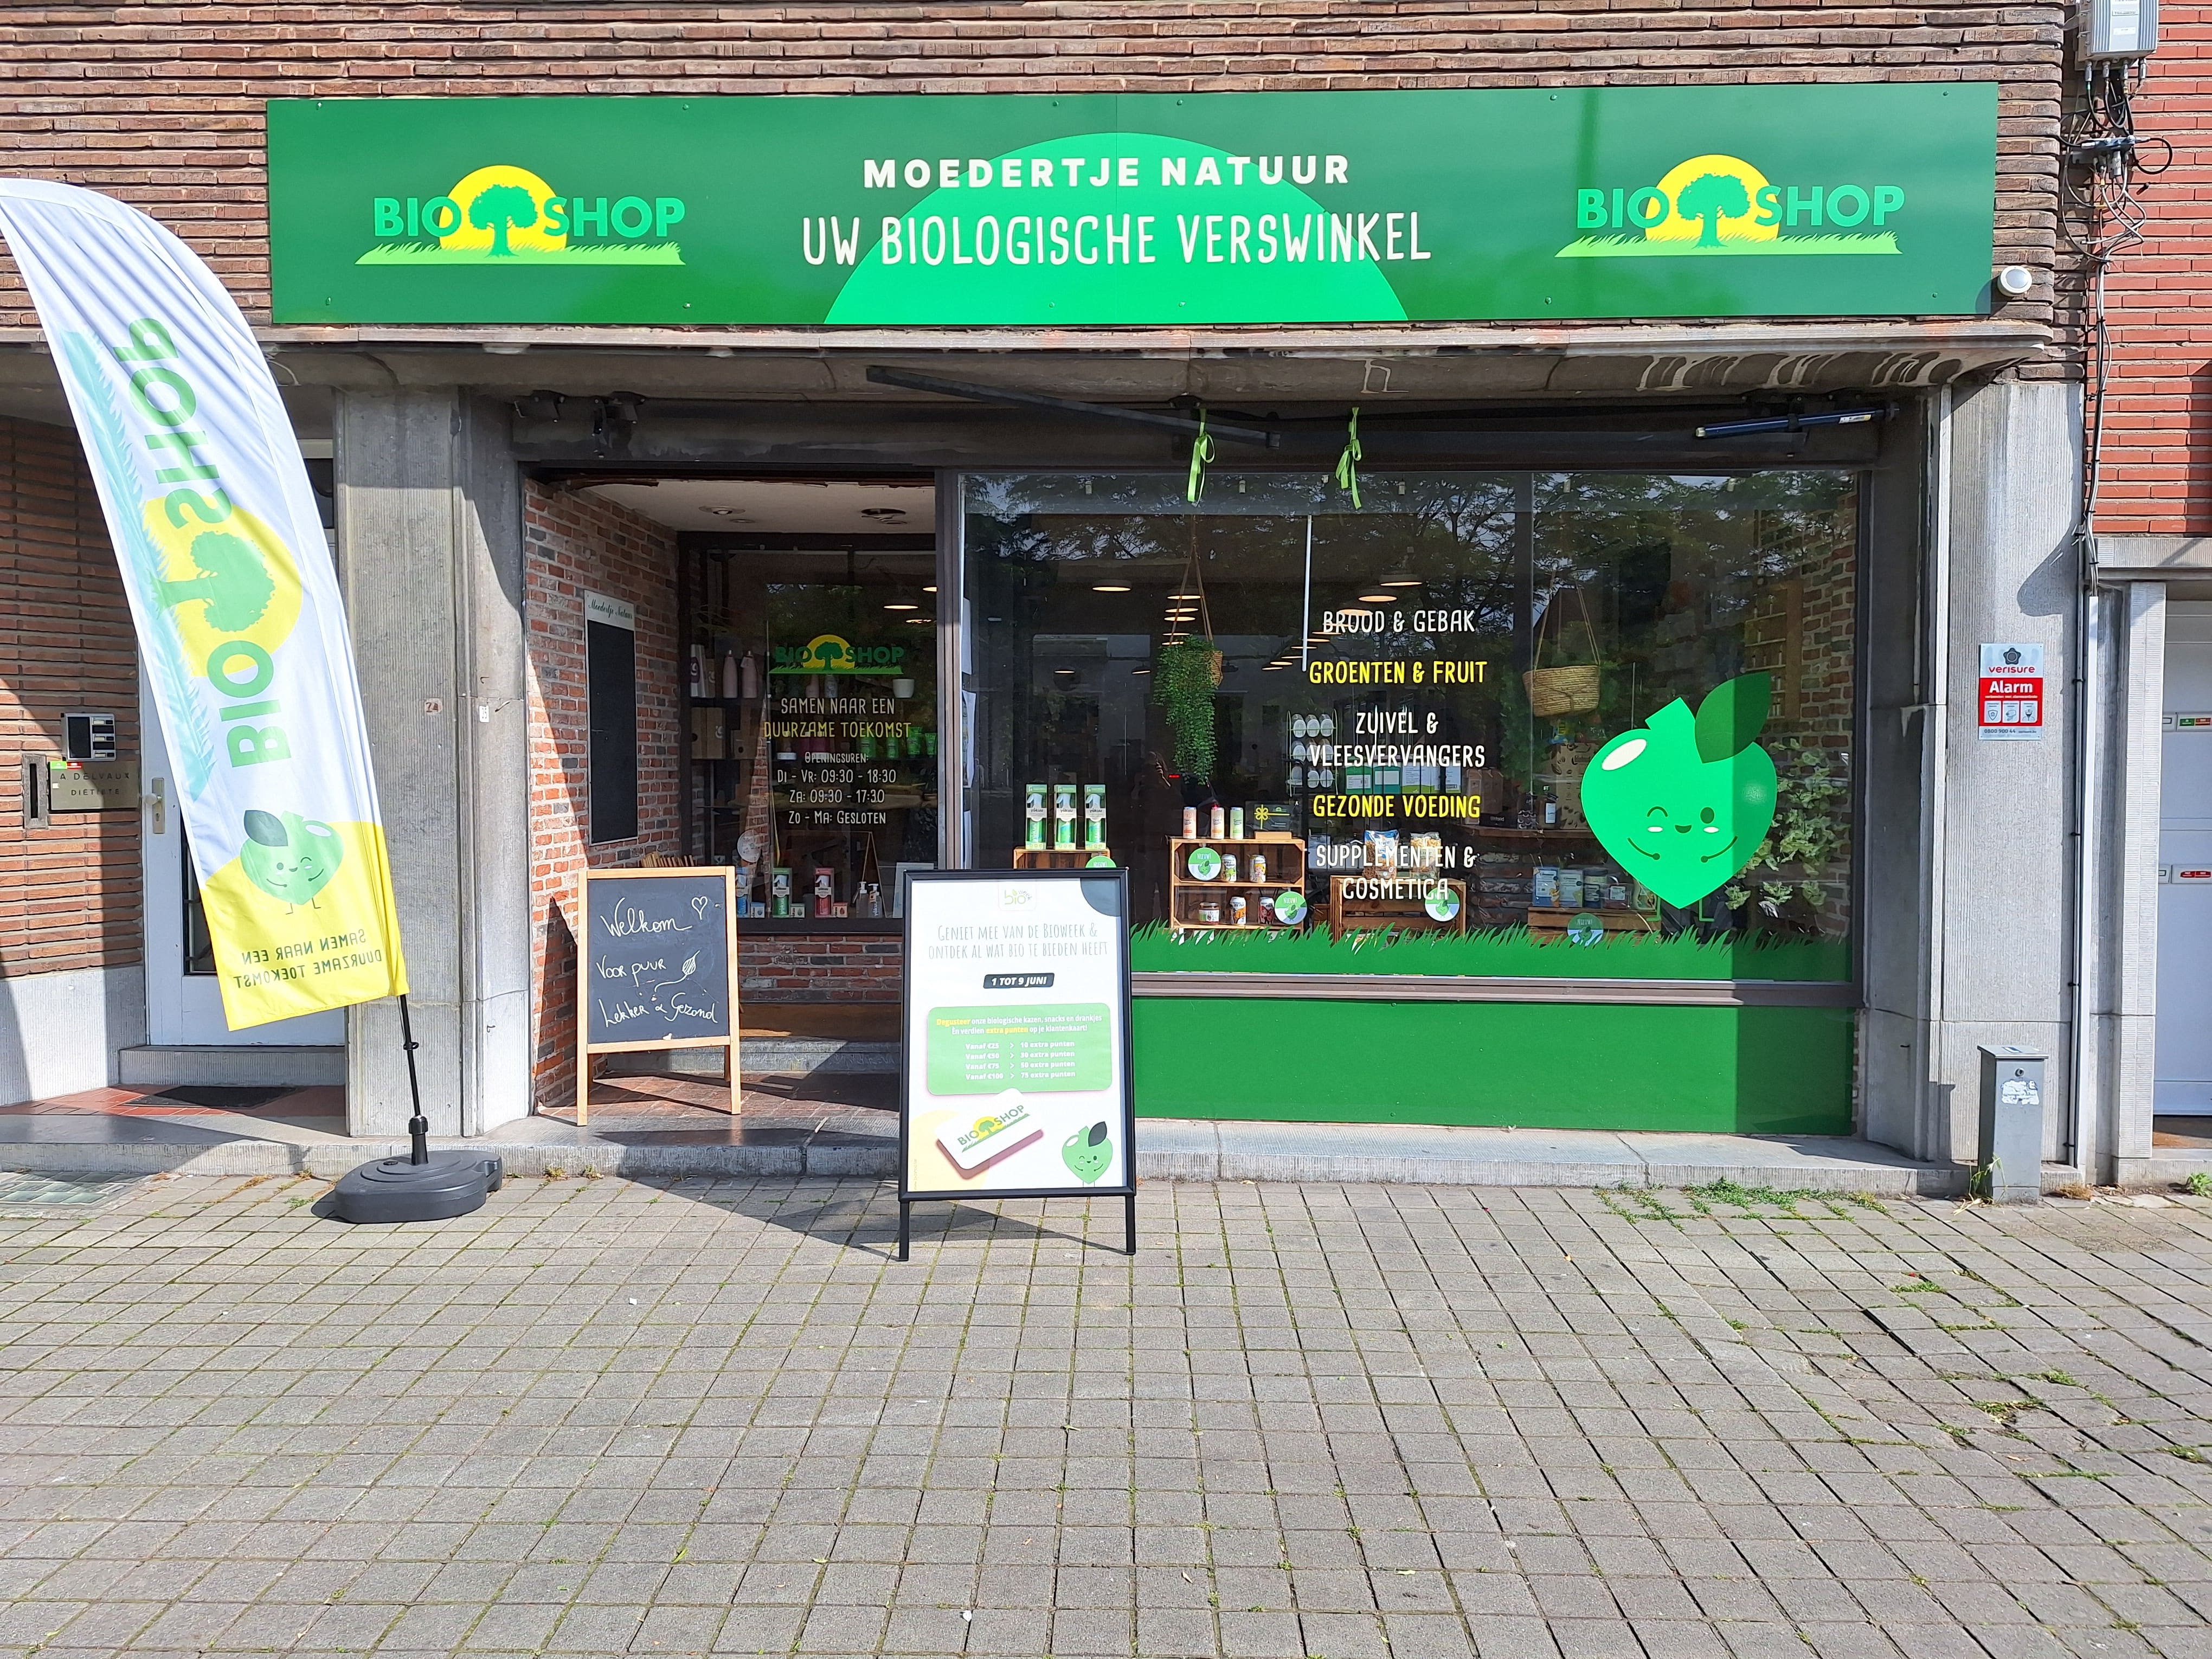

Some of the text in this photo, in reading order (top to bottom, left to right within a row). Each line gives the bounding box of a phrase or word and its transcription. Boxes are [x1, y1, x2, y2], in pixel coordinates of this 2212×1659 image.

[864, 155, 1349, 189] MOEDERTJE NATUUR
[374, 196, 686, 237] BIO SHOP
[1578, 184, 1906, 228] BIO SHOP
[803, 211, 1431, 266] UW BIOLOGISCHE VERSWINKEL
[1323, 610, 1475, 633] BROOD & GEBAK
[775, 646, 904, 663] BIO SHOP
[1310, 661, 1487, 683] GROENTEN & FRUIT
[1990, 680, 2033, 693] Alarm
[781, 698, 895, 714] SAMEN NAAR EEN
[764, 722, 911, 738] DUURZAME TOEKOMST
[1356, 712, 1438, 734] ZUIVEL &
[1310, 745, 1486, 767] VLEESVERVANGERS
[821, 770, 853, 782] 09:30
[867, 770, 896, 782] 18:30
[810, 790, 842, 802] 09:30
[856, 790, 885, 802] 17:30
[1314, 795, 1480, 818] GEZONDE VOEDING
[1316, 846, 1476, 868] SUPPLEMENTEN &
[1004, 890, 1026, 905] bio
[1342, 878, 1449, 900] COSMETICA
[600, 897, 693, 937] Welkom
[978, 925, 998, 940] MEE
[1002, 925, 1023, 939] VAN
[1028, 924, 1039, 938] DE
[1090, 922, 1098, 937] &
[929, 941, 1108, 960] ONTDEK AL WAT BIO TE BIEDEN HEEFT
[999, 978, 1017, 986] TOT
[1018, 977, 1024, 985] 9
[1025, 976, 1047, 986] JUNI
[664, 993, 718, 1023] Gezond
[936, 1019, 970, 1027] Degusteer
[987, 1017, 1022, 1025] biologische
[1075, 1014, 1102, 1024] drankjes
[1005, 1026, 1028, 1035] punten
[1050, 1051, 1075, 1059] punten
[957, 1105, 1024, 1145] BIO SHOP
